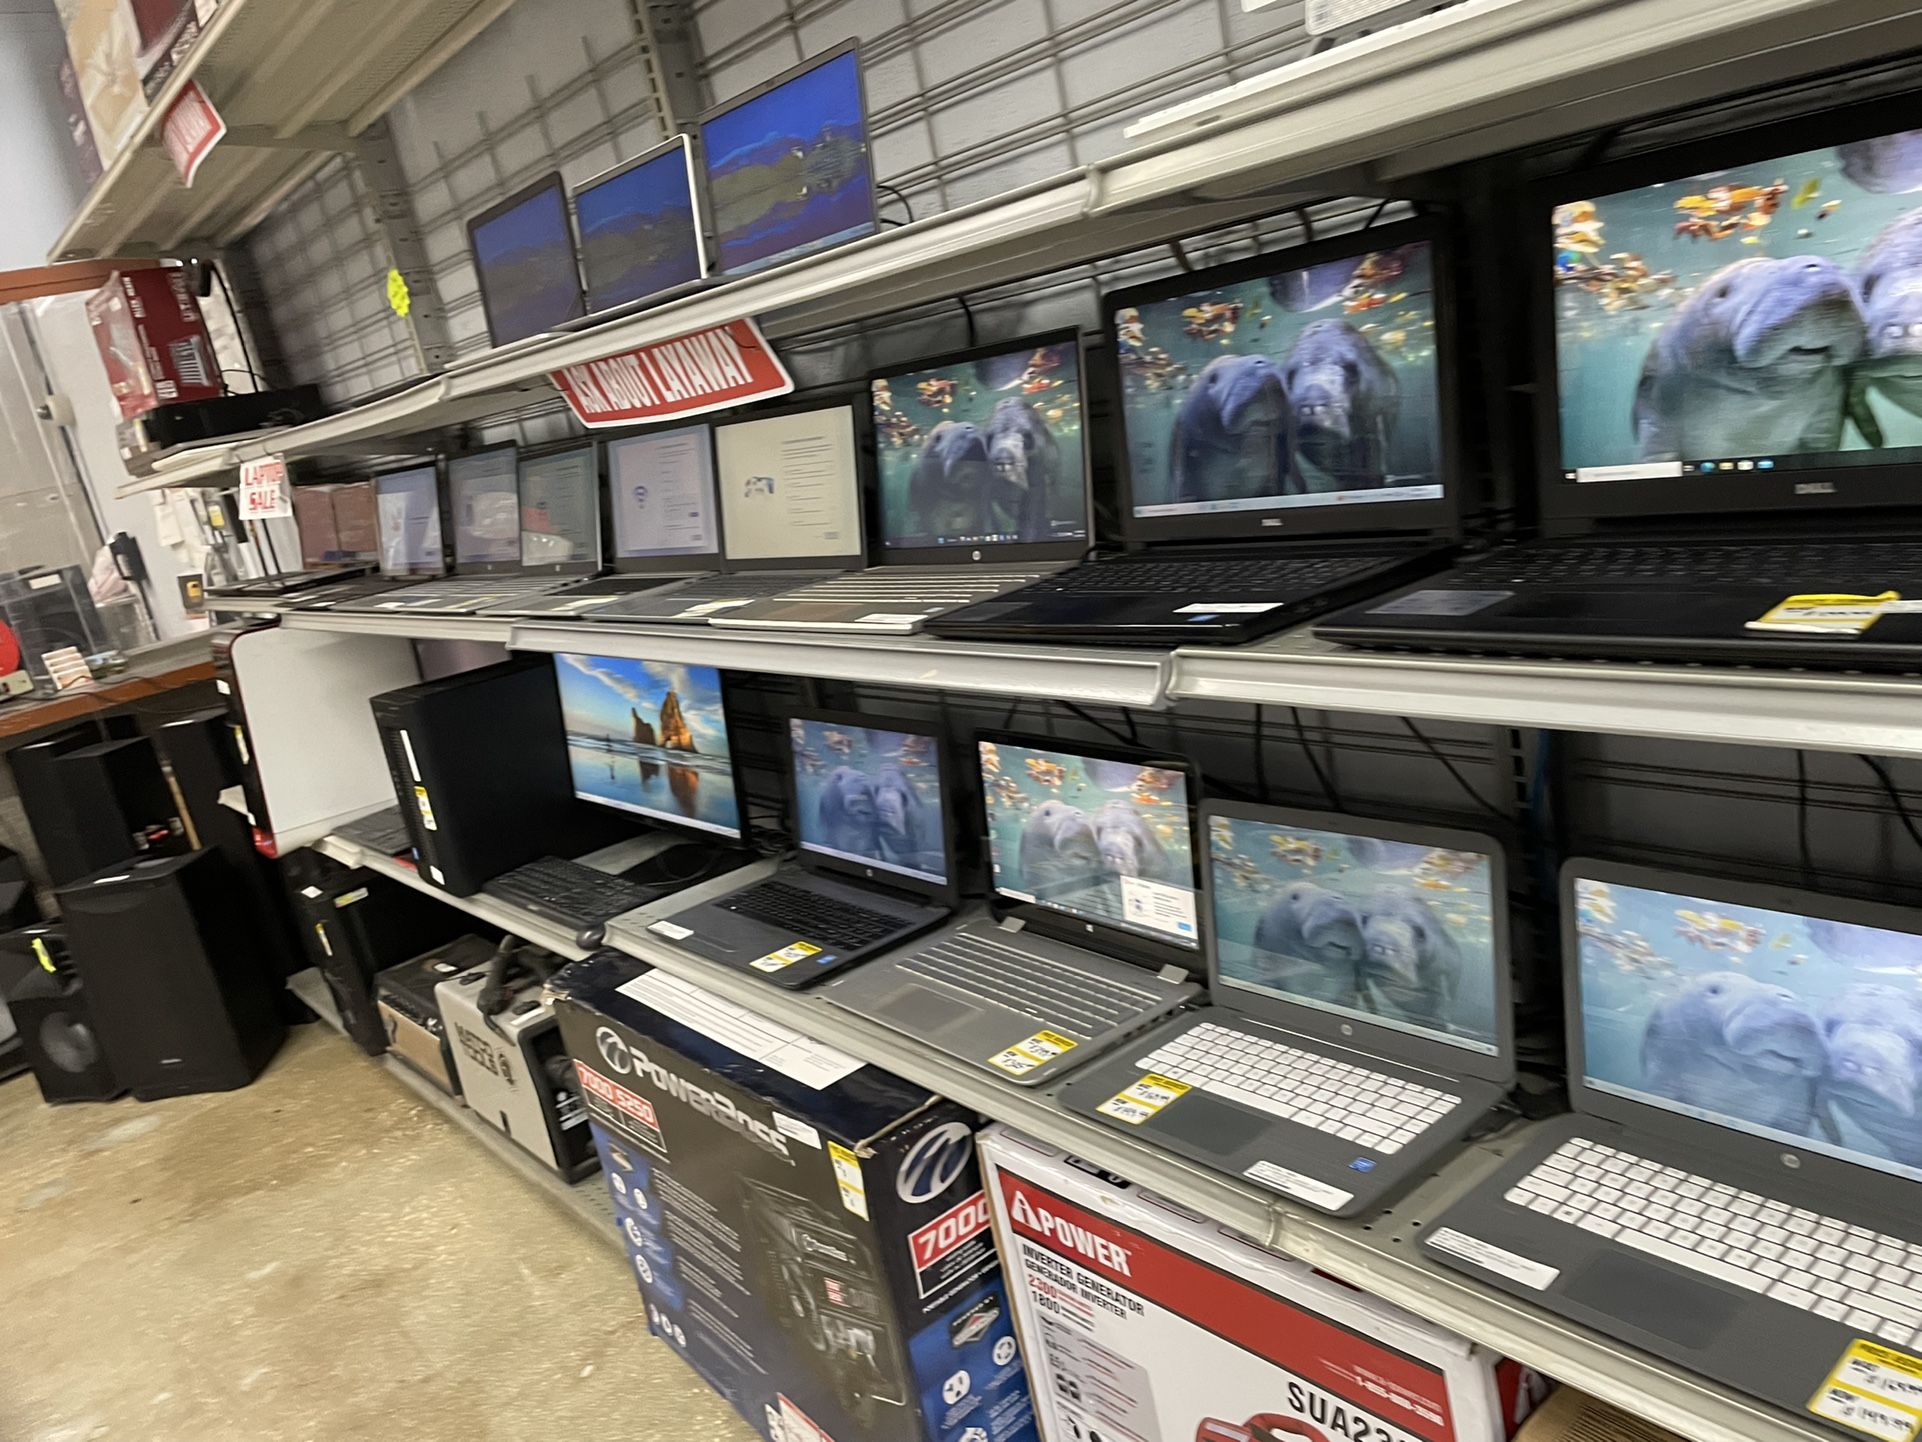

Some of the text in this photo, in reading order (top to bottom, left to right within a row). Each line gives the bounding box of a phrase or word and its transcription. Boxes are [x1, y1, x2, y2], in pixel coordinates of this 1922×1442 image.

[561, 326, 754, 414] ASK ABOUT LAYAWAY
[248, 490, 276, 511] SALE
[615, 1088, 656, 1125] 5250
[1022, 1243, 1074, 1281] INVERTER
[1076, 1271, 1145, 1317] GENERATOR
[1025, 1258, 1079, 1294] GENERADOR
[1027, 1273, 1057, 1298] 2300
[1030, 1290, 1061, 1314] 1800
